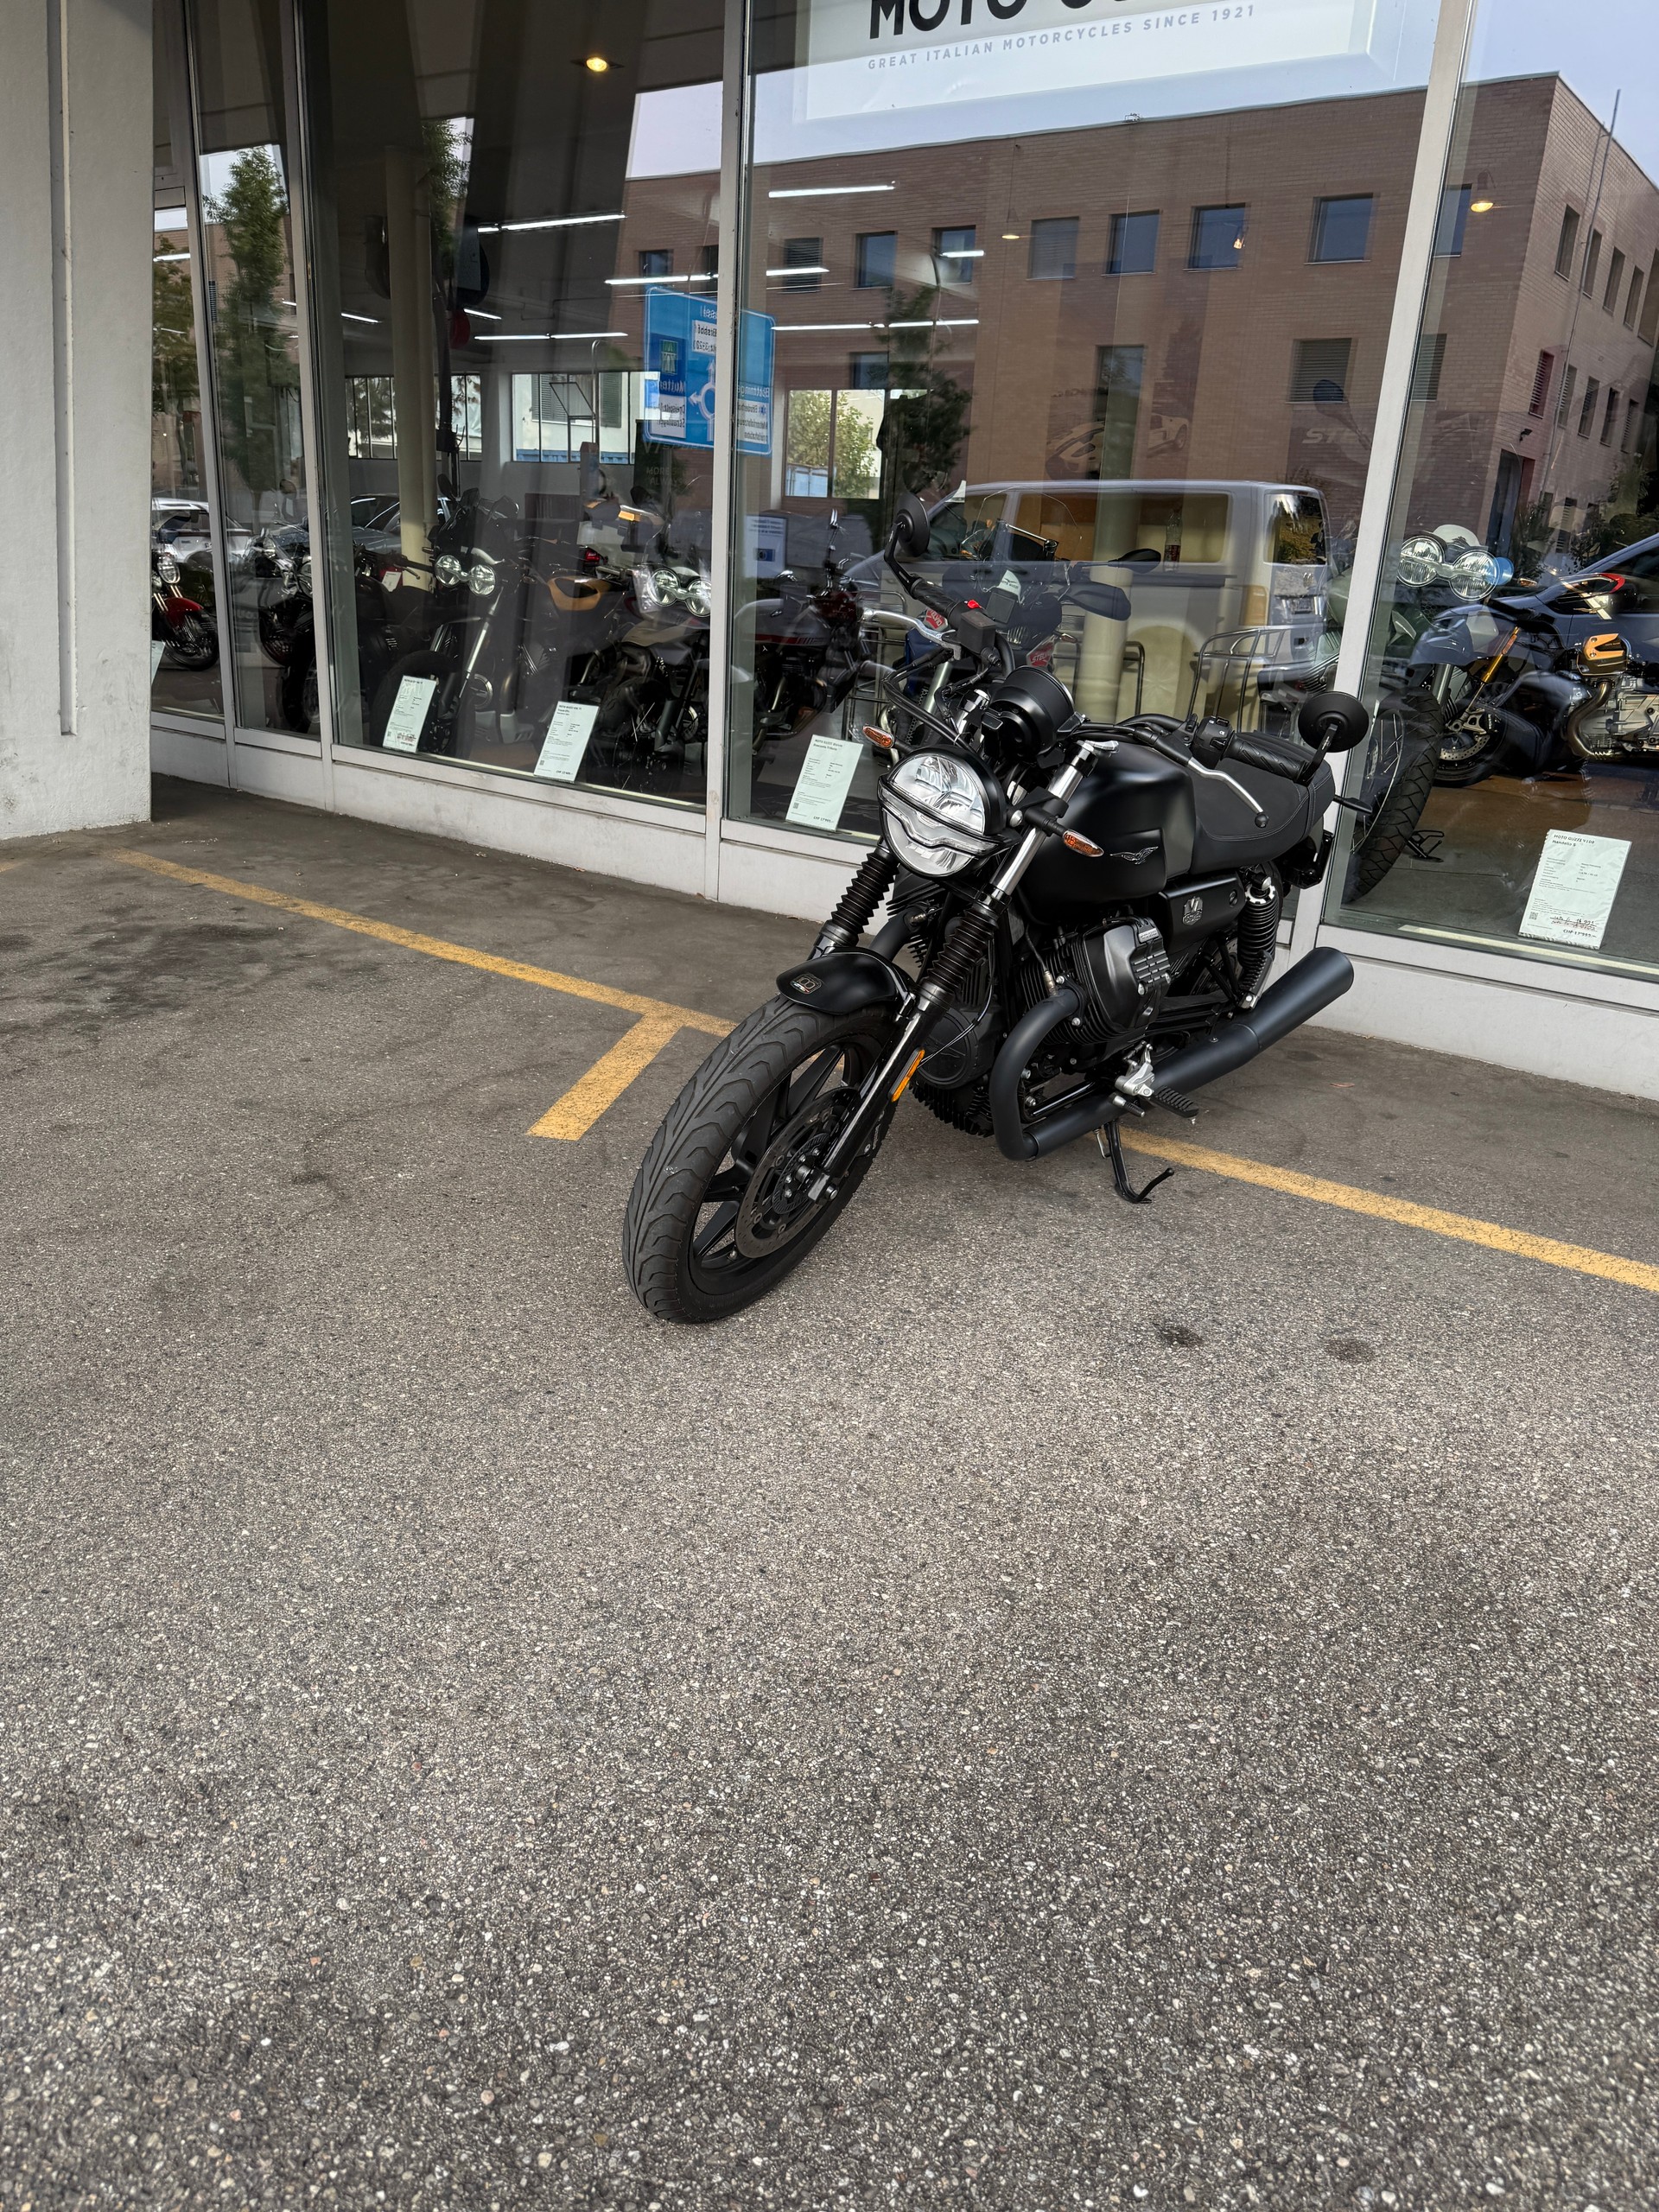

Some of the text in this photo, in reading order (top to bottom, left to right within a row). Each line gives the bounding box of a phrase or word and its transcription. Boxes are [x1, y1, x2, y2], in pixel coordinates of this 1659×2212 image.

[868, 5, 1255, 69] GREAT ITALIAN MOTORCYCLES SINCE 1921
